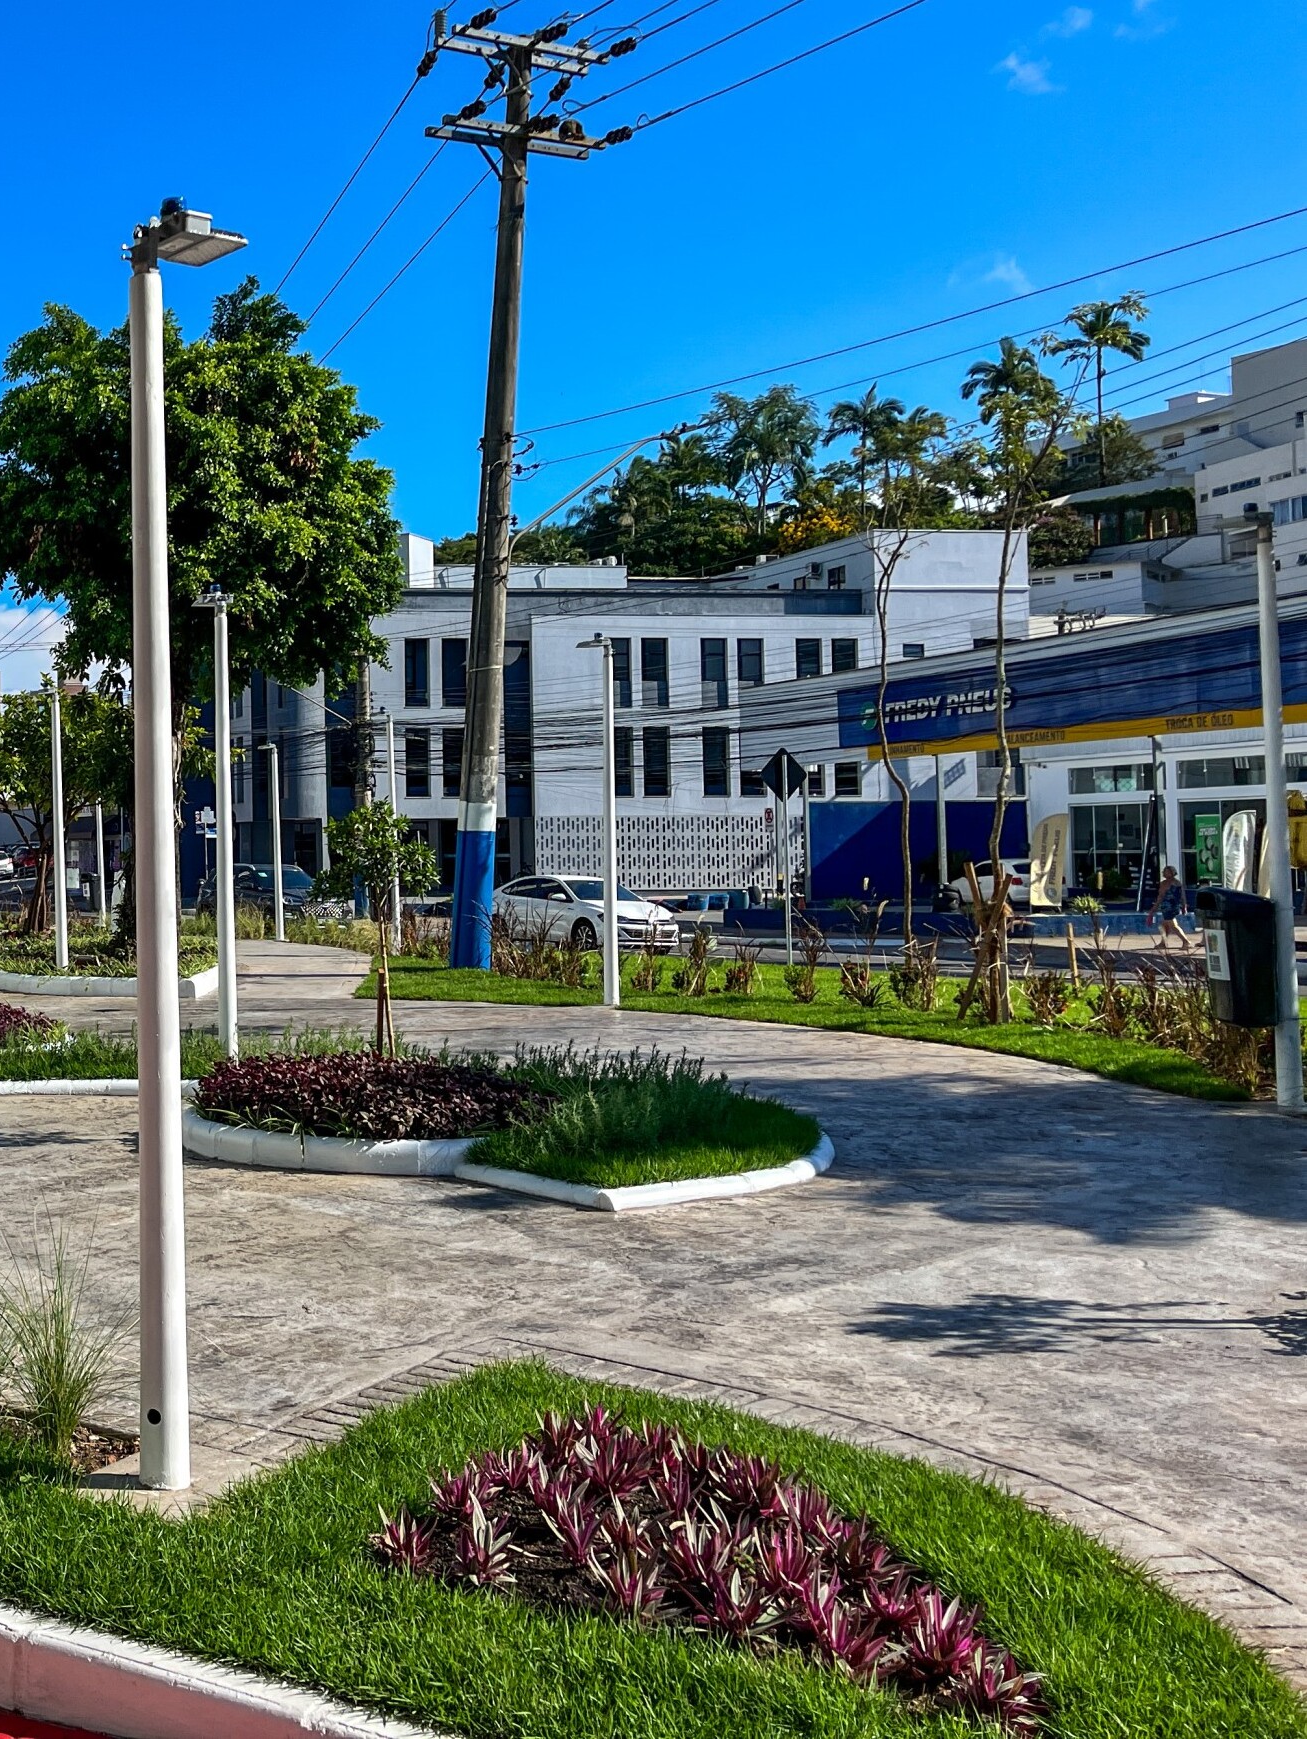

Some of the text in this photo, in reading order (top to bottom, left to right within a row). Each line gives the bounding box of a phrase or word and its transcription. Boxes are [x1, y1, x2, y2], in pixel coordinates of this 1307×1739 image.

[884, 695, 942, 724] FREDY
[1166, 717, 1193, 730] TROCA
[1197, 715, 1208, 728] DE
